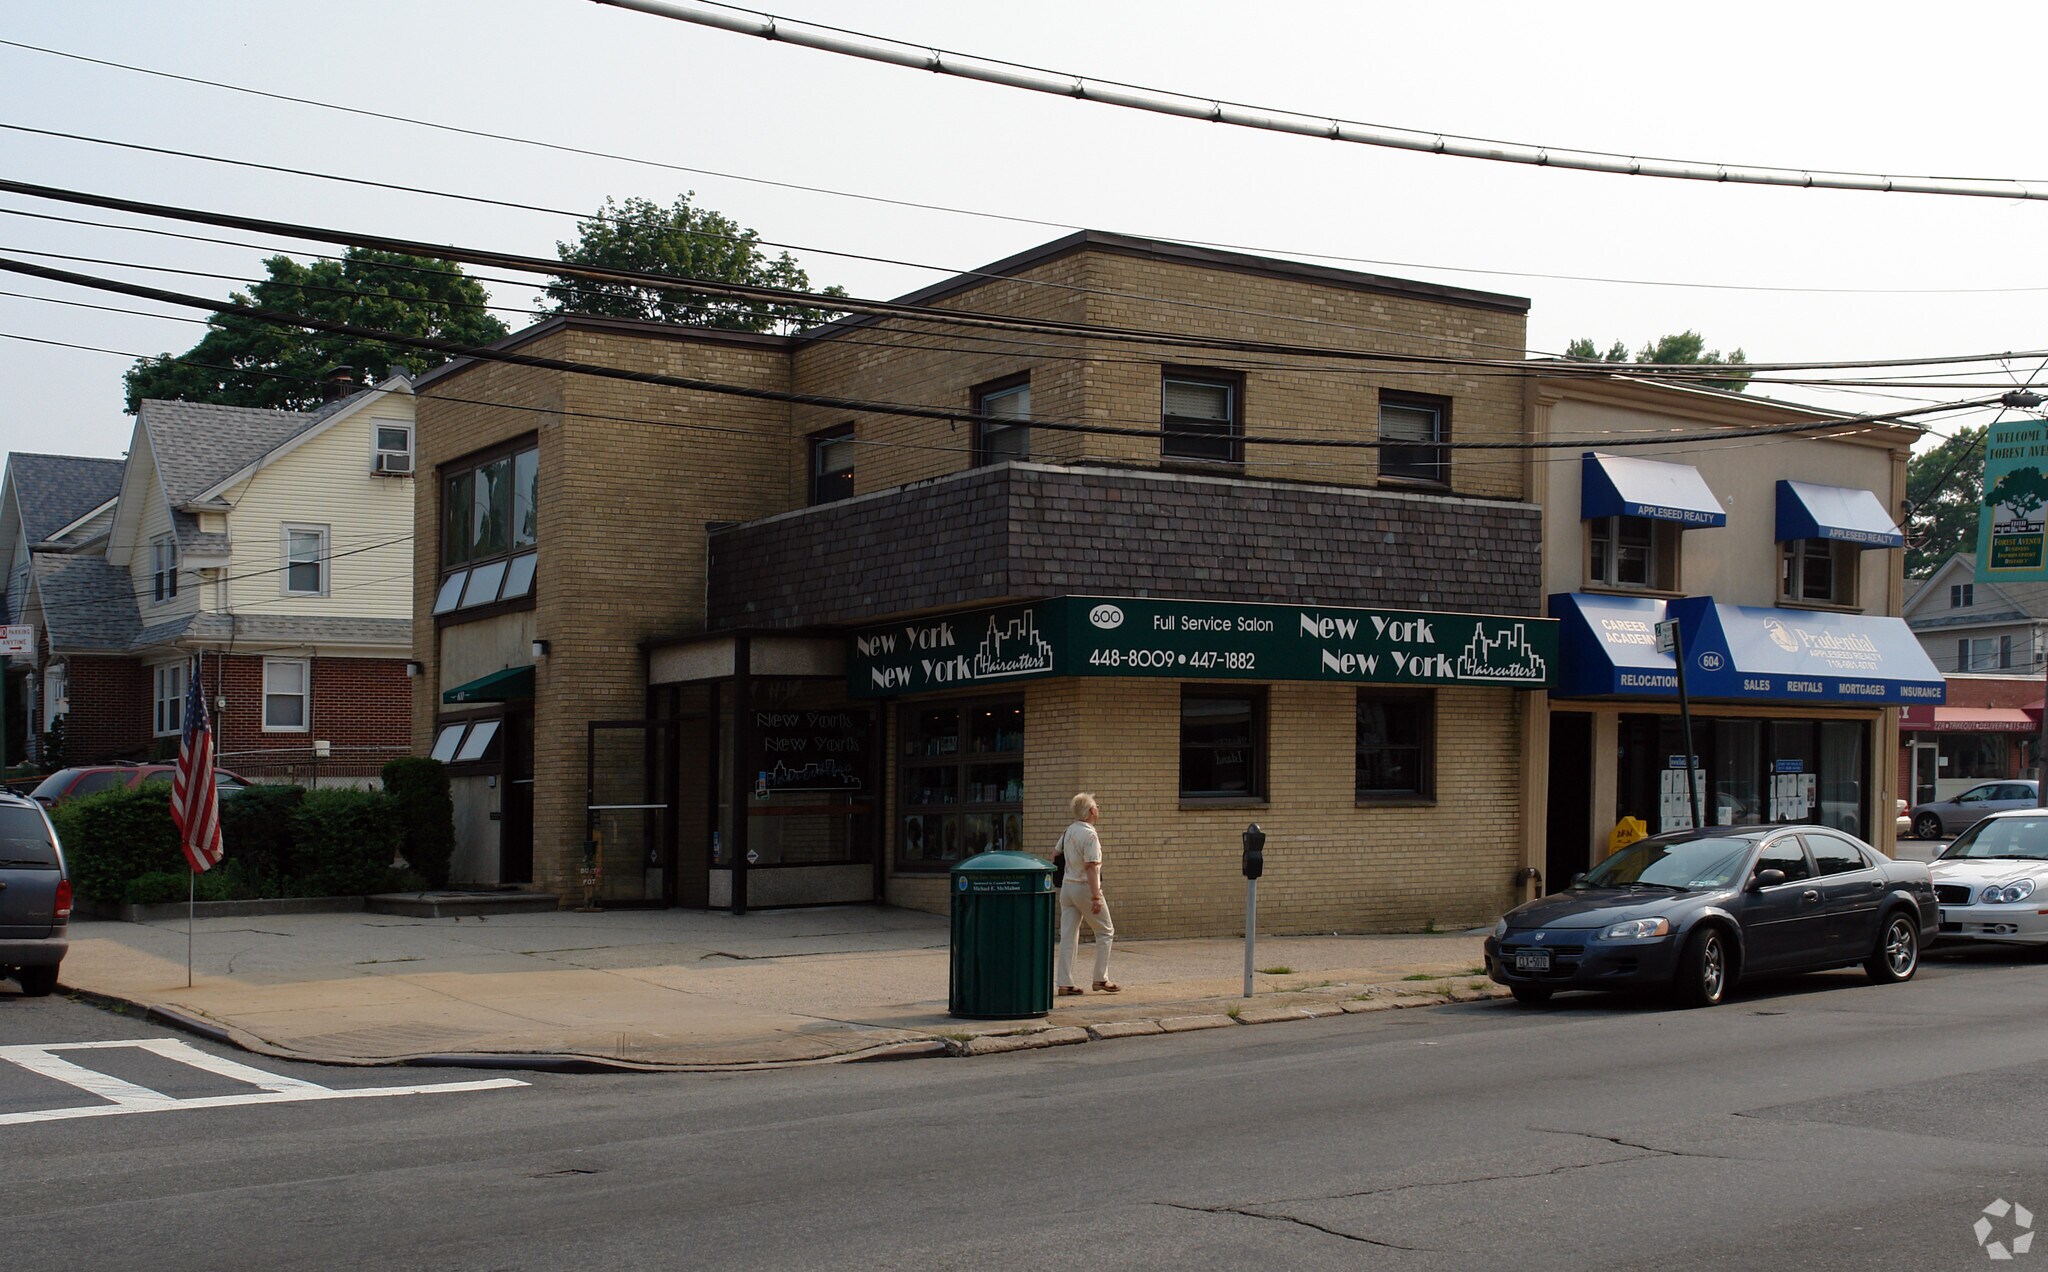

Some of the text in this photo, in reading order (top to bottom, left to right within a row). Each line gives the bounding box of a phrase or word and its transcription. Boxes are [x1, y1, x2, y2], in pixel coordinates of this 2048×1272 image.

[1996, 430, 2039, 443] WELCOME
[1990, 447, 2025, 460] FOREST
[1638, 505, 1715, 524] APPLESEED REALTY
[1829, 528, 1894, 544] APPLESEED REALTY
[1092, 610, 1121, 623] 600
[1153, 615, 1274, 632] Full Service Salon
[1300, 612, 1435, 644] New York
[1601, 619, 1650, 632] CAREER
[857, 622, 955, 659] New York
[1795, 629, 1878, 653] Prudential
[982, 653, 1045, 674] Haircutters
[1089, 649, 1255, 669] 448-8009 447-1882
[1322, 648, 1454, 678] New York
[1703, 656, 1719, 667] 604
[1809, 650, 1883, 662] APPLESEED REALTY
[872, 654, 972, 690] New York
[1467, 658, 1537, 677] Haircutters
[1621, 674, 1678, 687] RELOCATION
[1744, 679, 1942, 698] SALES RENTALS MORTGAGES INSURANCE
[757, 713, 853, 728] New York
[765, 737, 860, 752] New York
